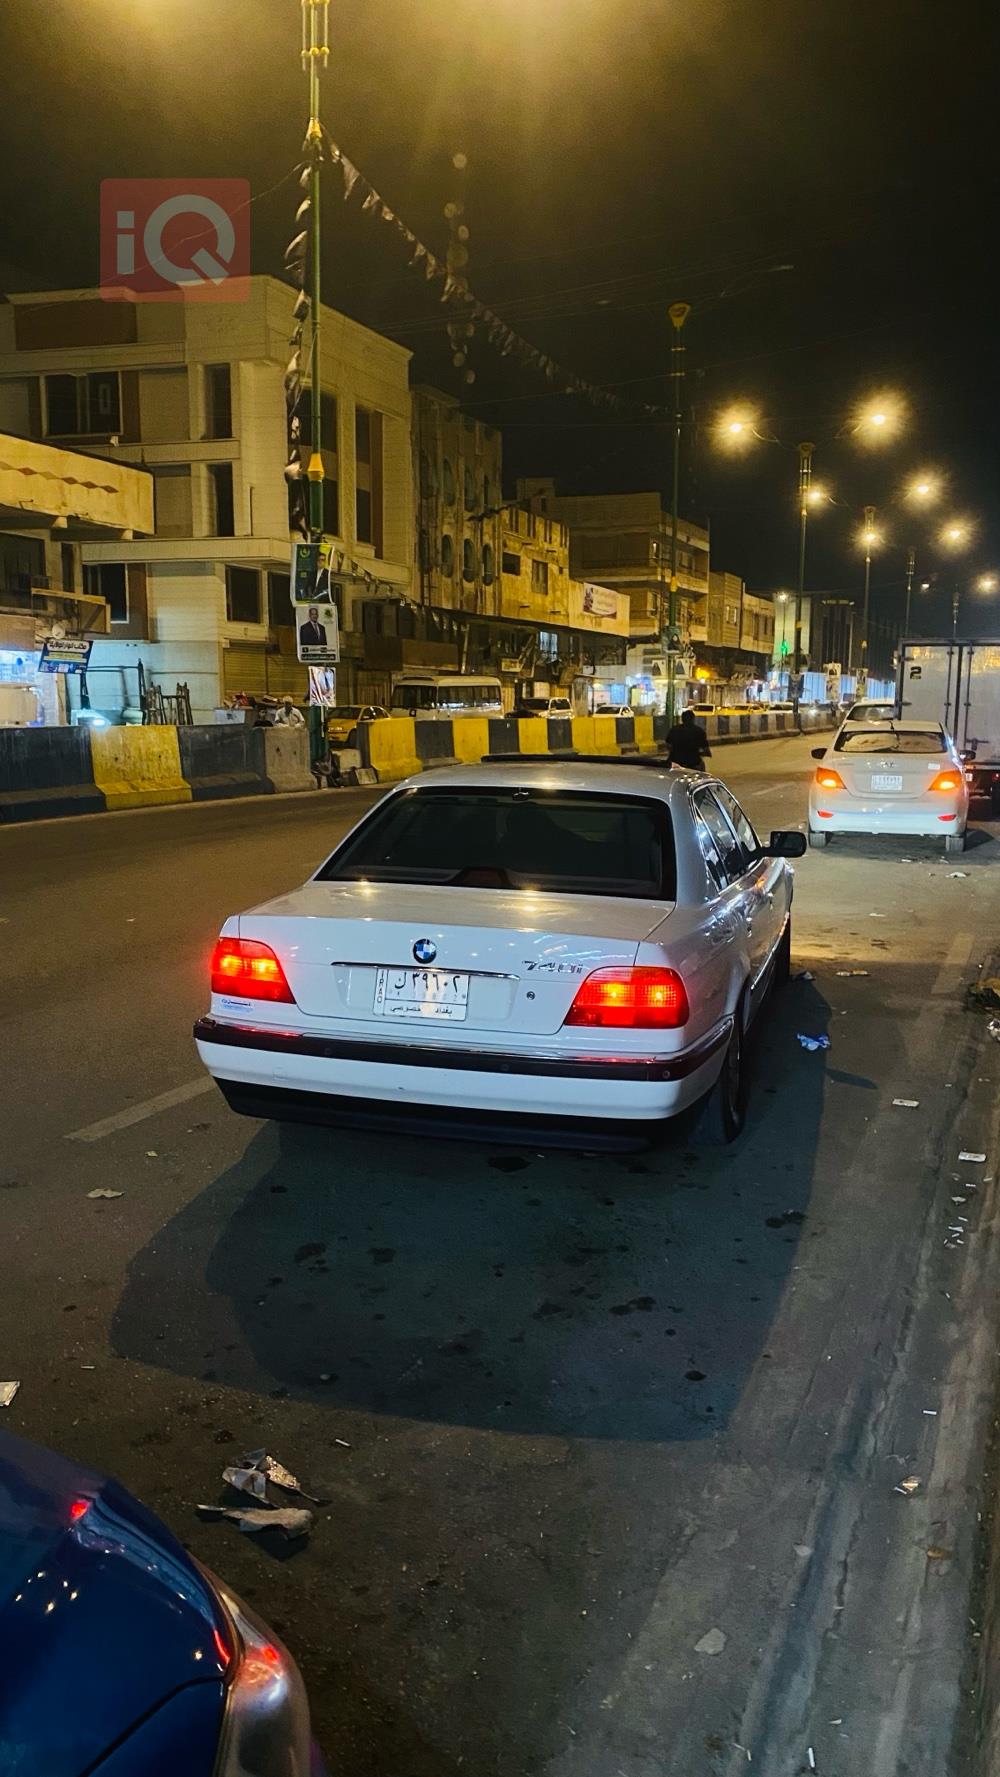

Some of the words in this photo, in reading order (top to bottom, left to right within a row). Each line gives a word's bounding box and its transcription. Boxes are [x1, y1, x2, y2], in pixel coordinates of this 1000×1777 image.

[910, 666, 921, 679] 2
[521, 960, 583, 975] 740i
[376, 970, 384, 1004] IRAQ
[435, 1005, 453, 1017] بغداد
